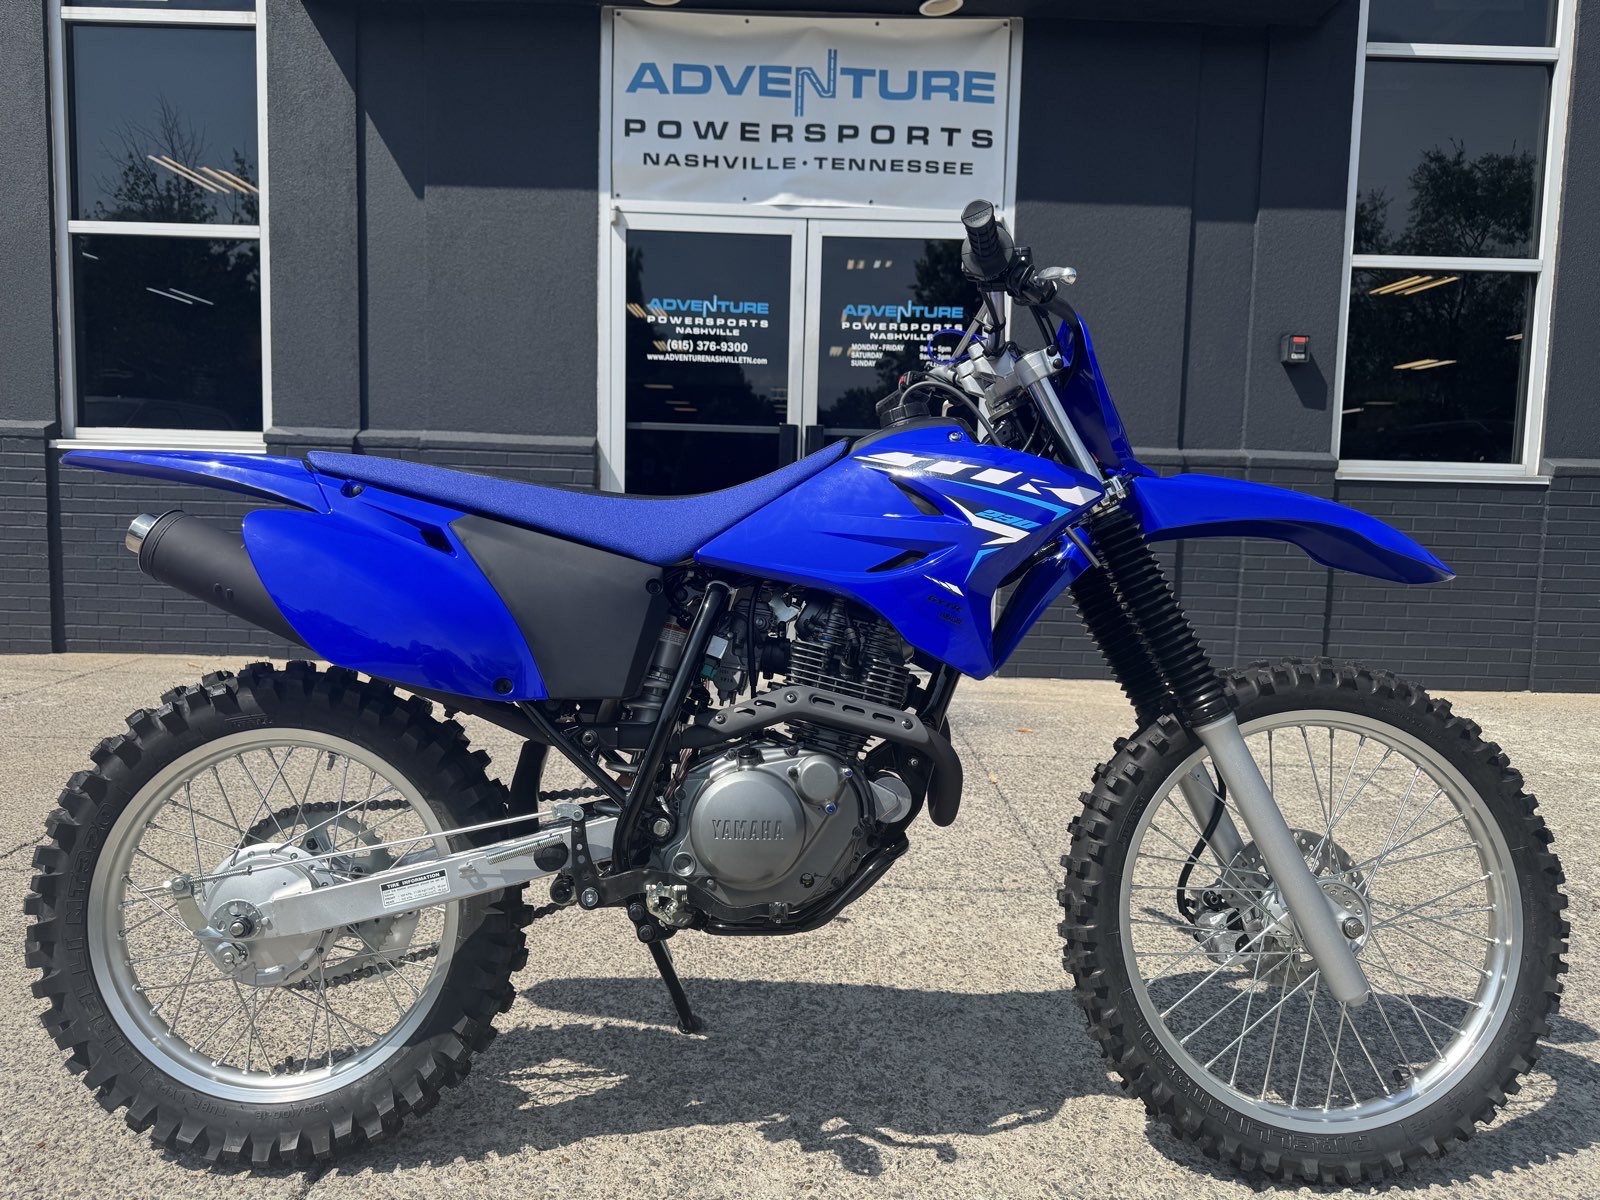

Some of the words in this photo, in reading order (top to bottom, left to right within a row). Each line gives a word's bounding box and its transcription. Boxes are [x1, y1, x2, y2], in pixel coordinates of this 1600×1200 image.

[625, 49, 996, 117] ADVENTURE
[624, 118, 994, 149] POWERSPORTS
[647, 294, 769, 318] ADVENTURE
[843, 300, 964, 323] ADVENTURE
[646, 315, 769, 328] POWERSPORTS
[841, 322, 963, 332] POWERSPORTS
[675, 326, 740, 336] NASHVILLE
[870, 332, 934, 341] NASHVILLE
[666, 338, 694, 352] (615)
[696, 341, 749, 352] 376-9300
[851, 351, 883, 359] SATURDAY
[711, 819, 784, 840] YAMAHA
[402, 872, 440, 886] INFORMATION
